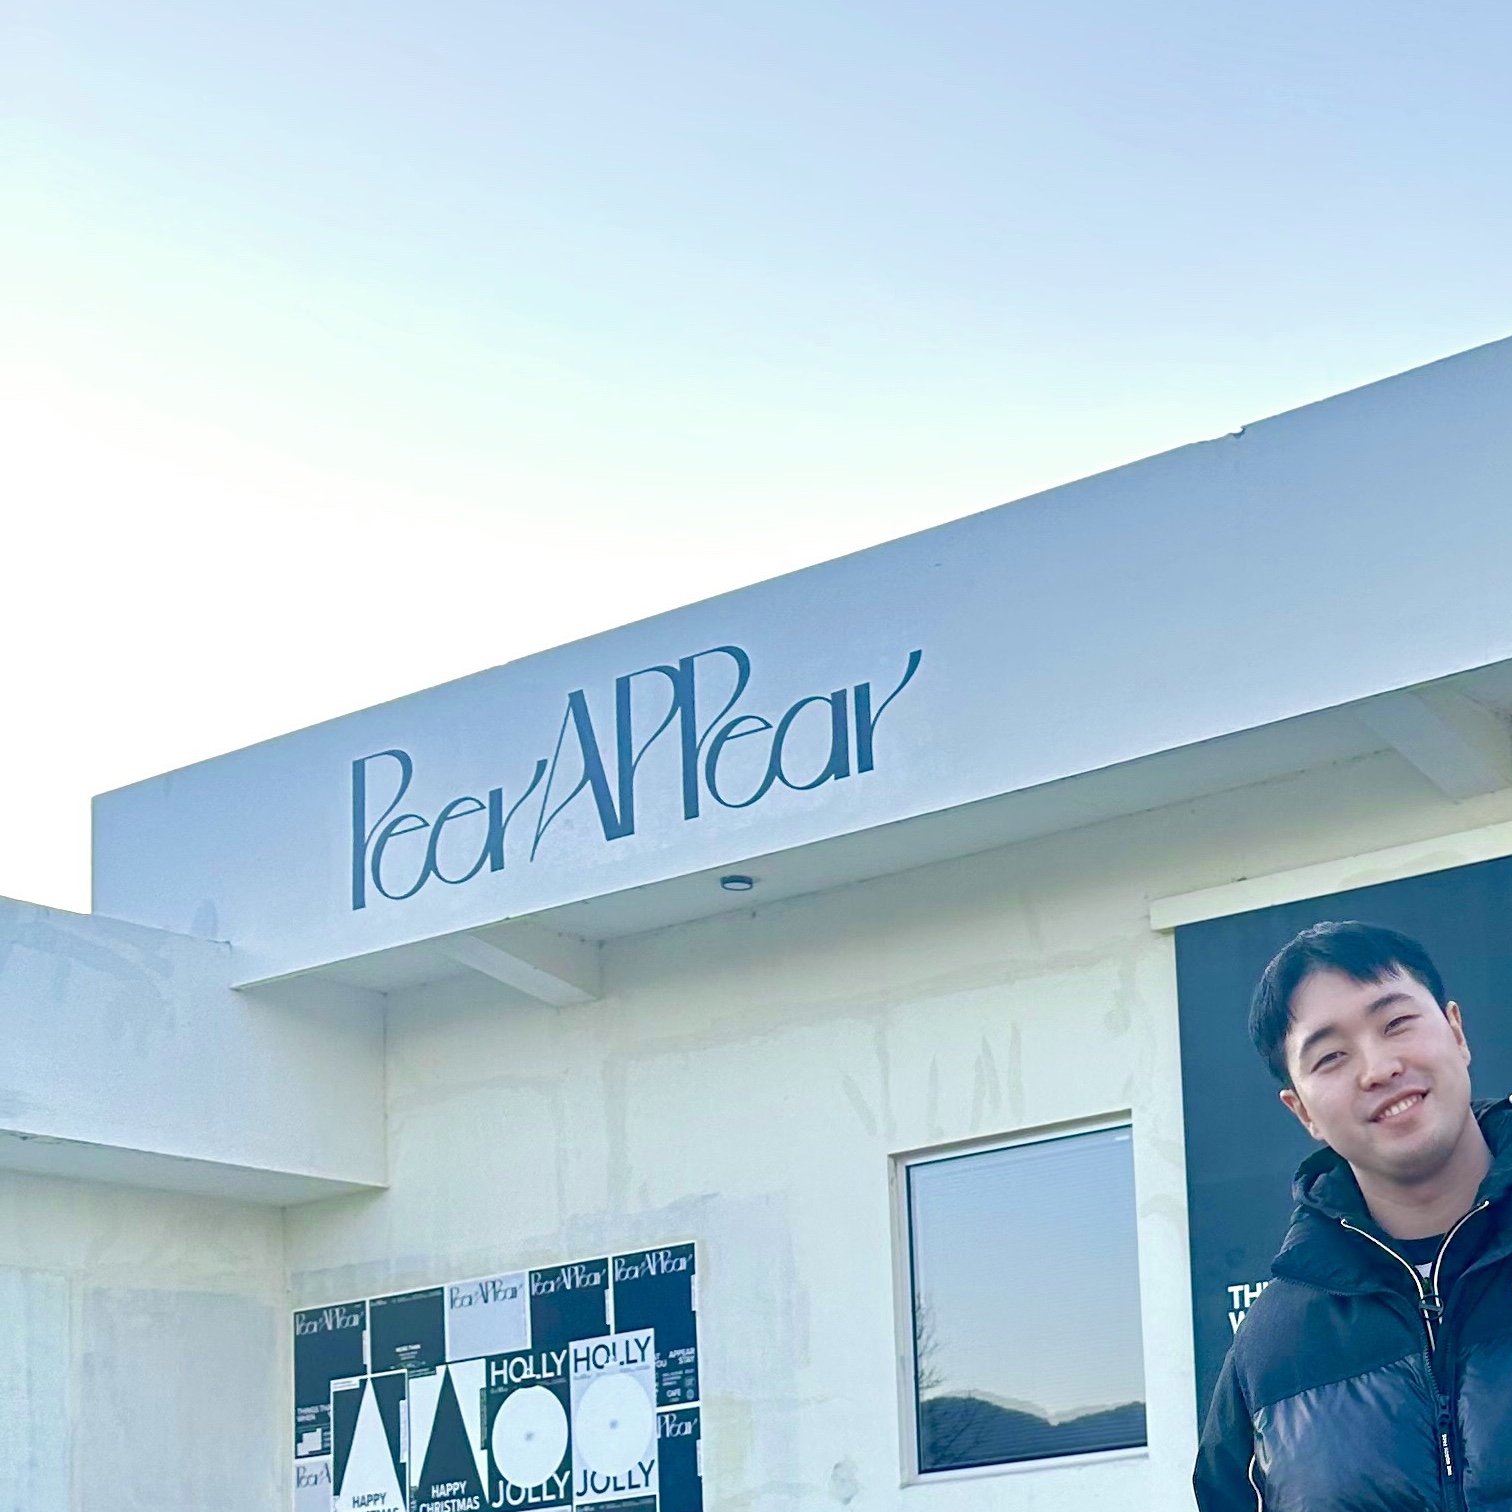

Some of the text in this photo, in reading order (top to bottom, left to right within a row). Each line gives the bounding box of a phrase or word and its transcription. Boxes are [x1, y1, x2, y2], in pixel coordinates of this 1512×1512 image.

[491, 1350, 567, 1386] HOLLY
[574, 1336, 651, 1373] HOLLY
[352, 1492, 387, 1508] HAPPY
[432, 1480, 467, 1499] HAPPY
